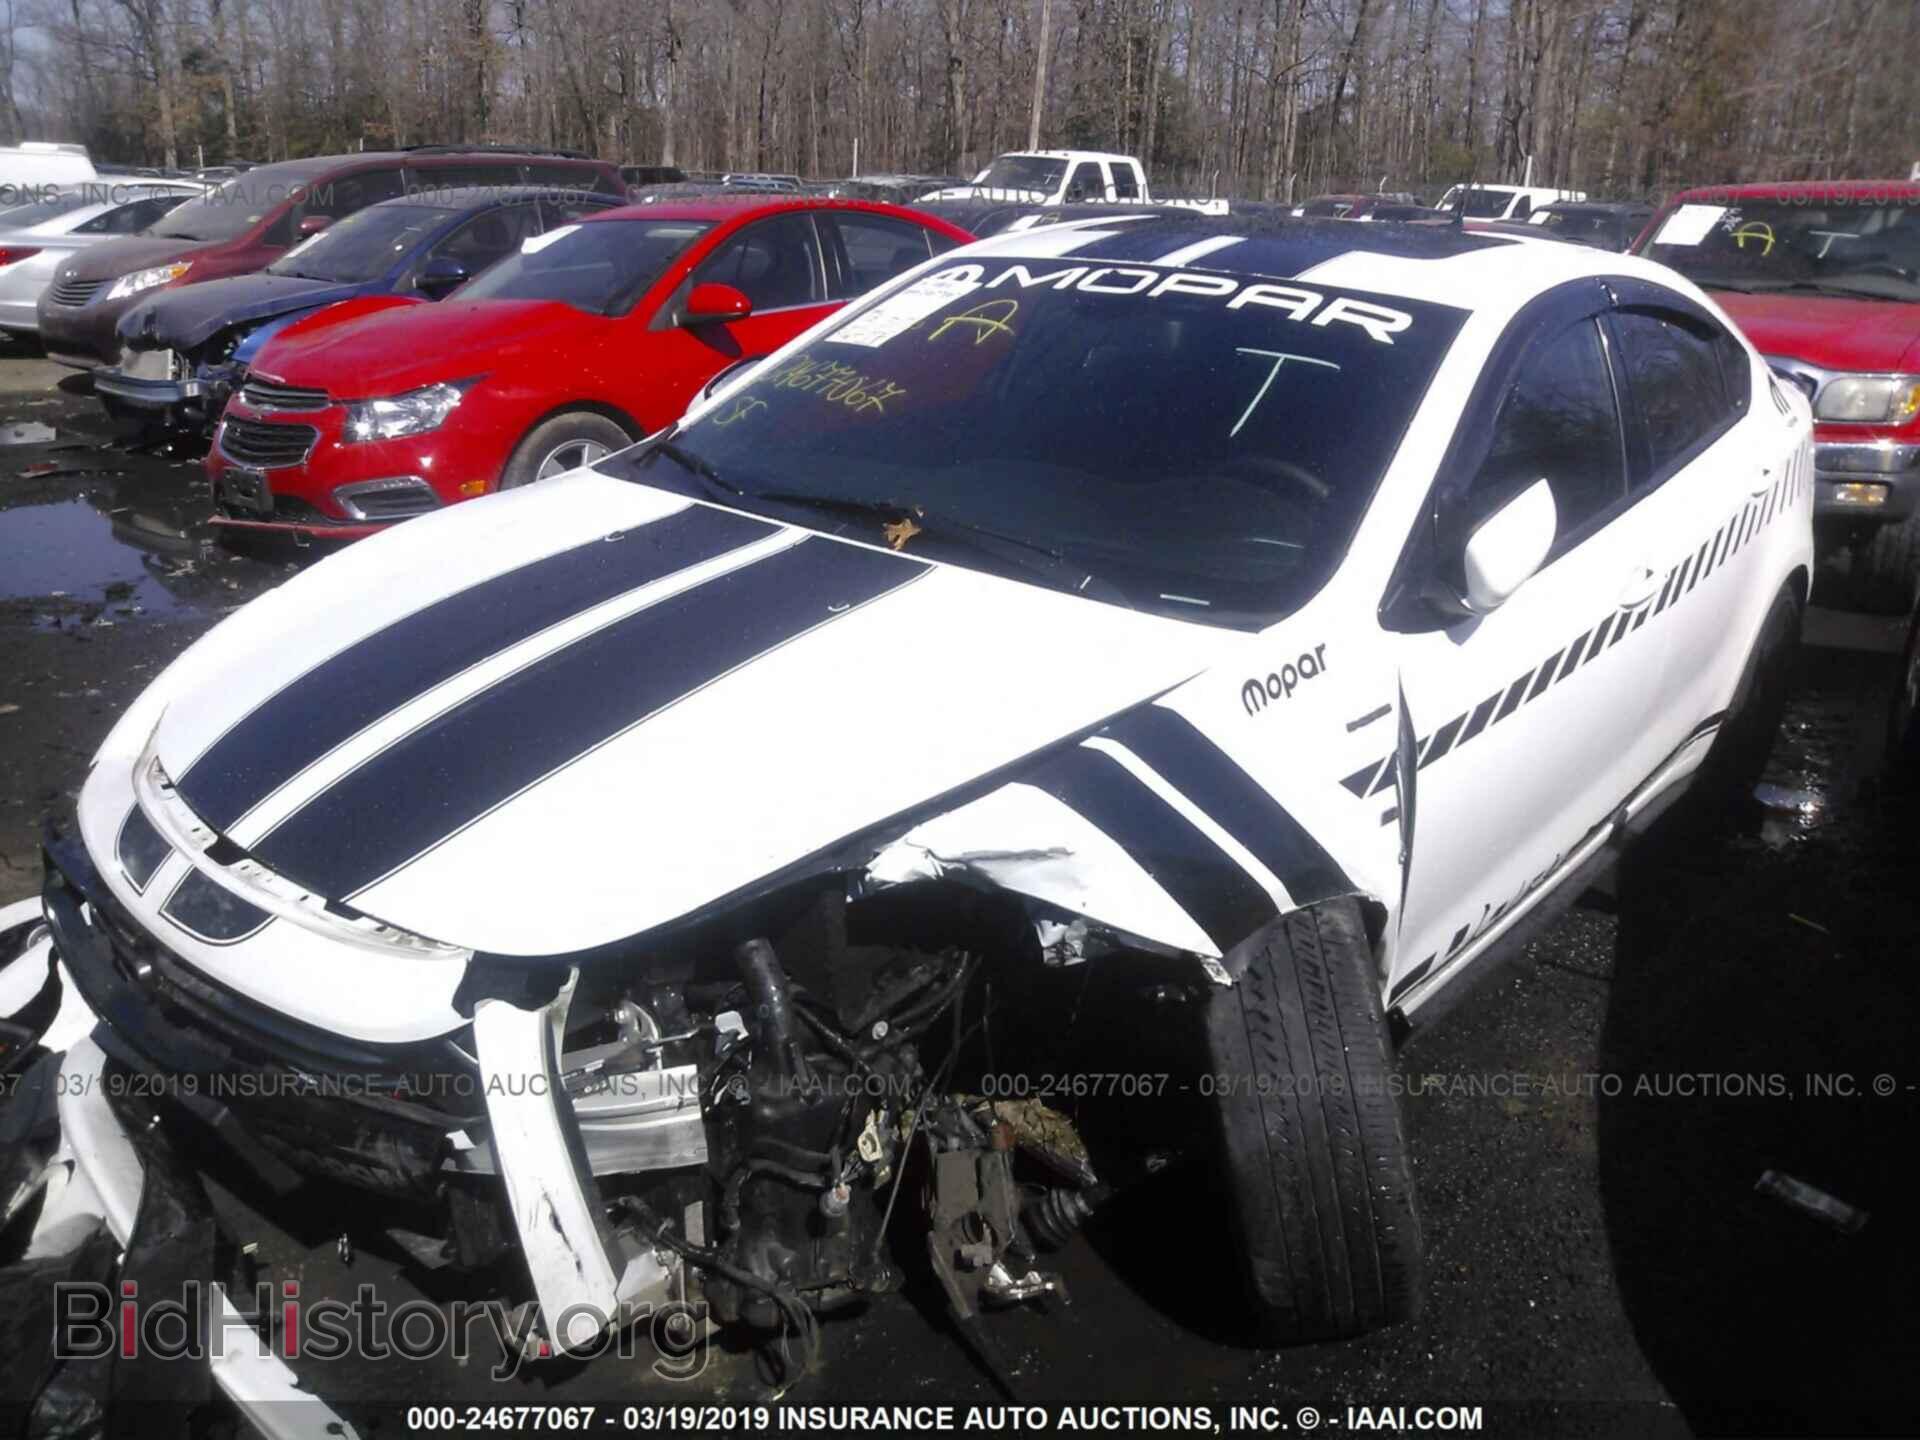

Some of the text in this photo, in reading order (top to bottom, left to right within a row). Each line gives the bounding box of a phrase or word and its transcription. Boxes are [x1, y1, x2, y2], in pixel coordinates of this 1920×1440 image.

[985, 265, 1412, 344] MOPAR
[1230, 346, 1341, 437] T
[1241, 642, 1327, 718] Mopar
